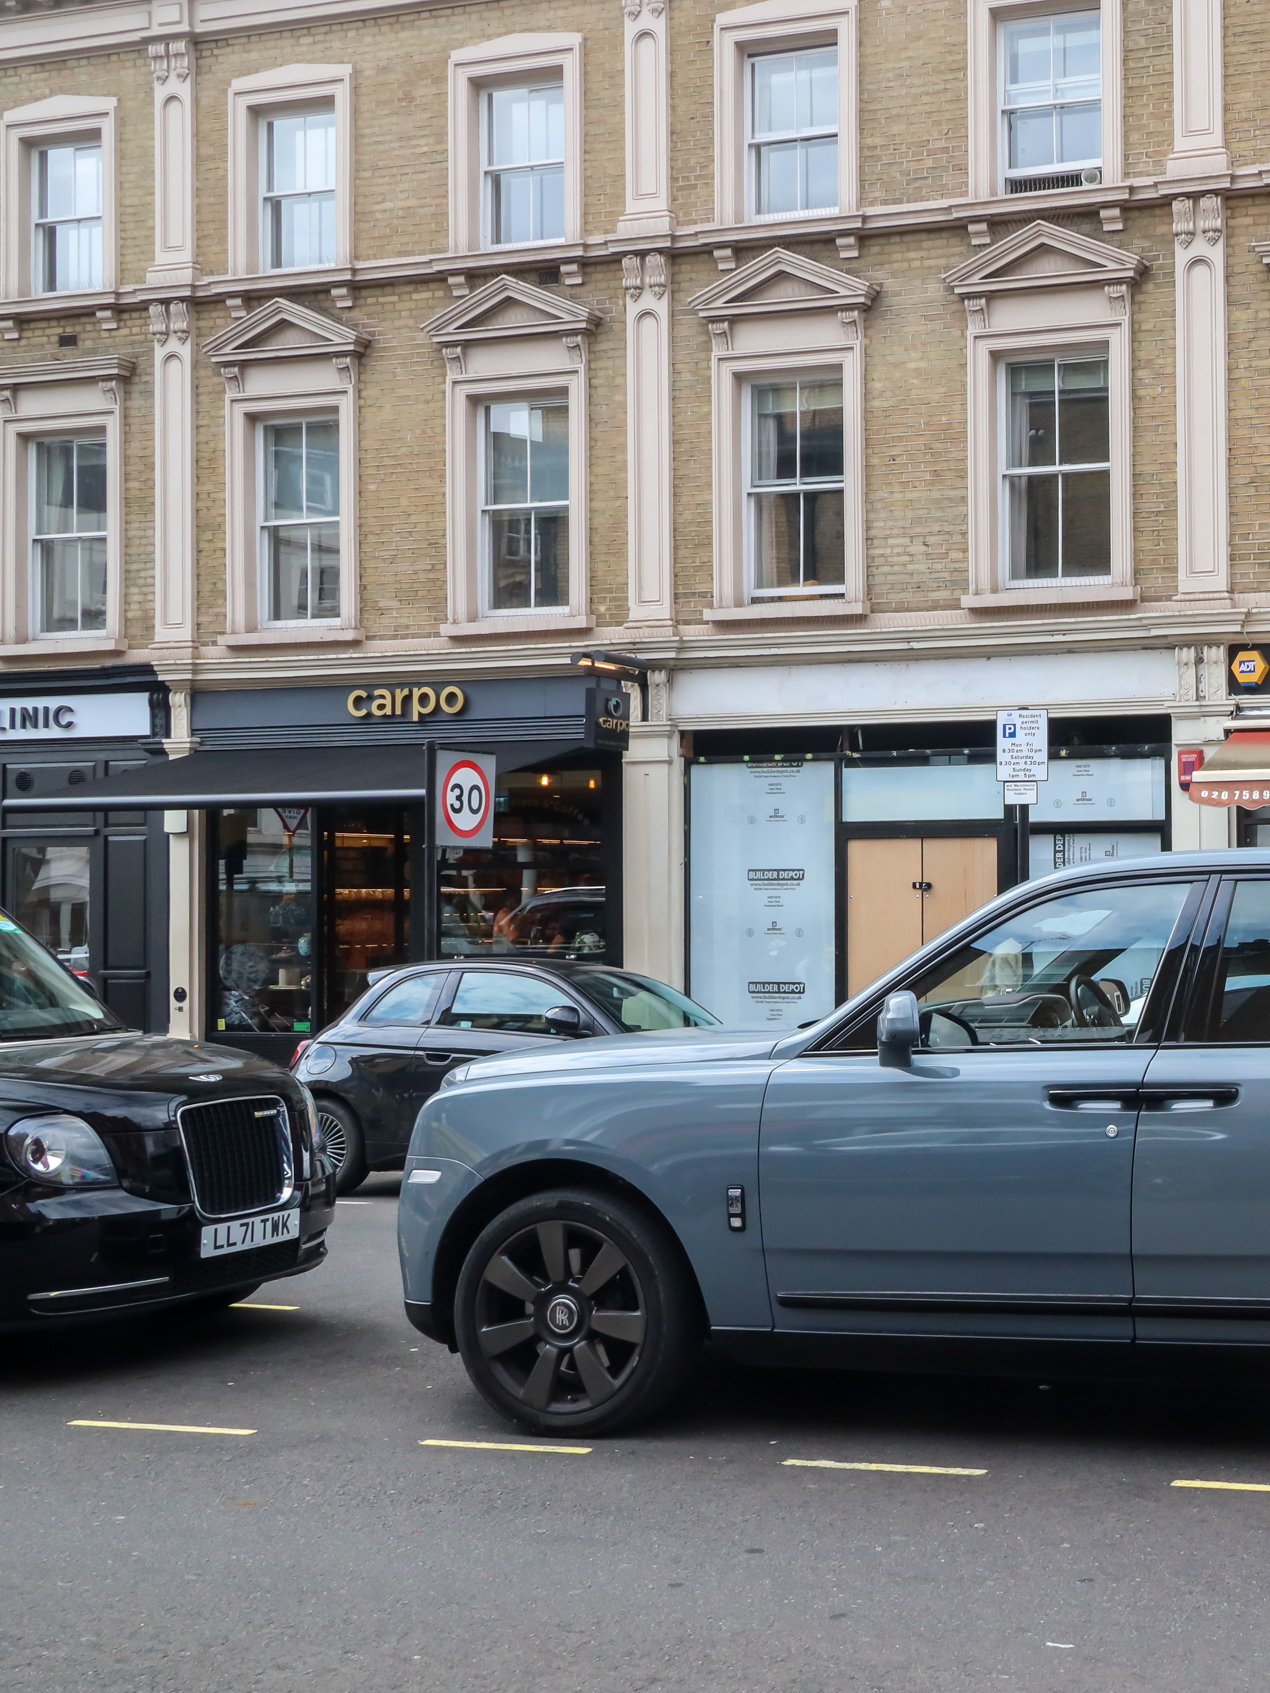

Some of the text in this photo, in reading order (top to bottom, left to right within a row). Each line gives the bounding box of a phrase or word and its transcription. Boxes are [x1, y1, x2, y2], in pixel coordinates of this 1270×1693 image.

[1239, 661, 1256, 672] ADT
[346, 685, 465, 722] carpo
[449, 782, 483, 815] 30
[1200, 790, 1229, 800] 020
[1233, 789, 1270, 800] 7589
[748, 870, 804, 879] BUILDER DEPOT
[748, 983, 805, 992] BUILDER DEPOT
[213, 1213, 291, 1251] LL71 TWK
